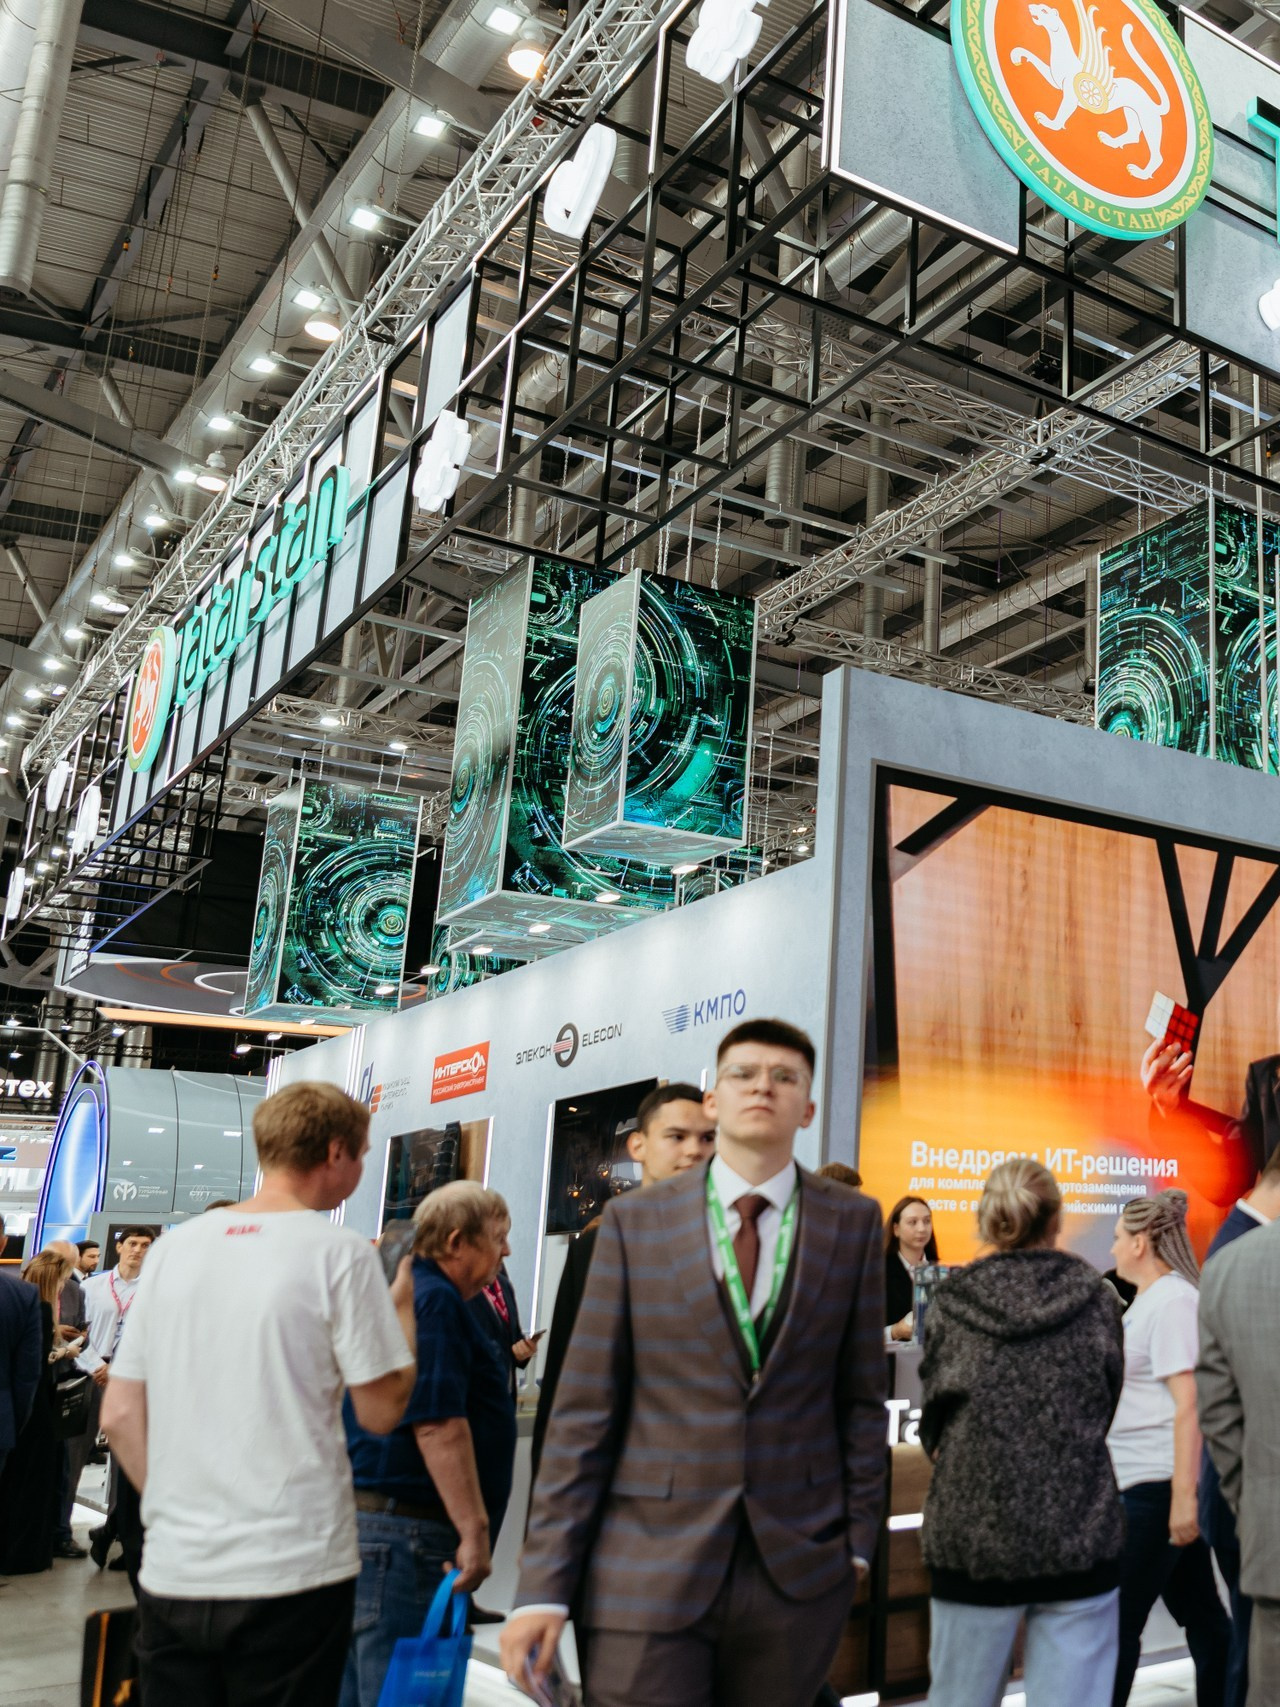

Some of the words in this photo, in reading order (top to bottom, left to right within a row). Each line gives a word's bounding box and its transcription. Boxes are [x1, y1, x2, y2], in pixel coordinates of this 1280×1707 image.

[1024, 148, 1157, 230] ТАТАРСТАН
[174, 465, 350, 706] Tatarstan
[694, 989, 746, 1026] КМПО
[582, 1023, 623, 1047] ELECON
[434, 1051, 486, 1080] ИНТЕРСКОЛ
[515, 1044, 551, 1065] ЭЛЕКОН
[1045, 1147, 1178, 1179] ИТ-решения
[908, 1176, 935, 1191] для
[937, 1177, 986, 1191] компле
[1056, 1182, 1147, 1197] ортозамещения
[927, 1199, 957, 1212] есте
[960, 1200, 968, 1212] с
[1062, 1199, 1117, 1214] ийскими
